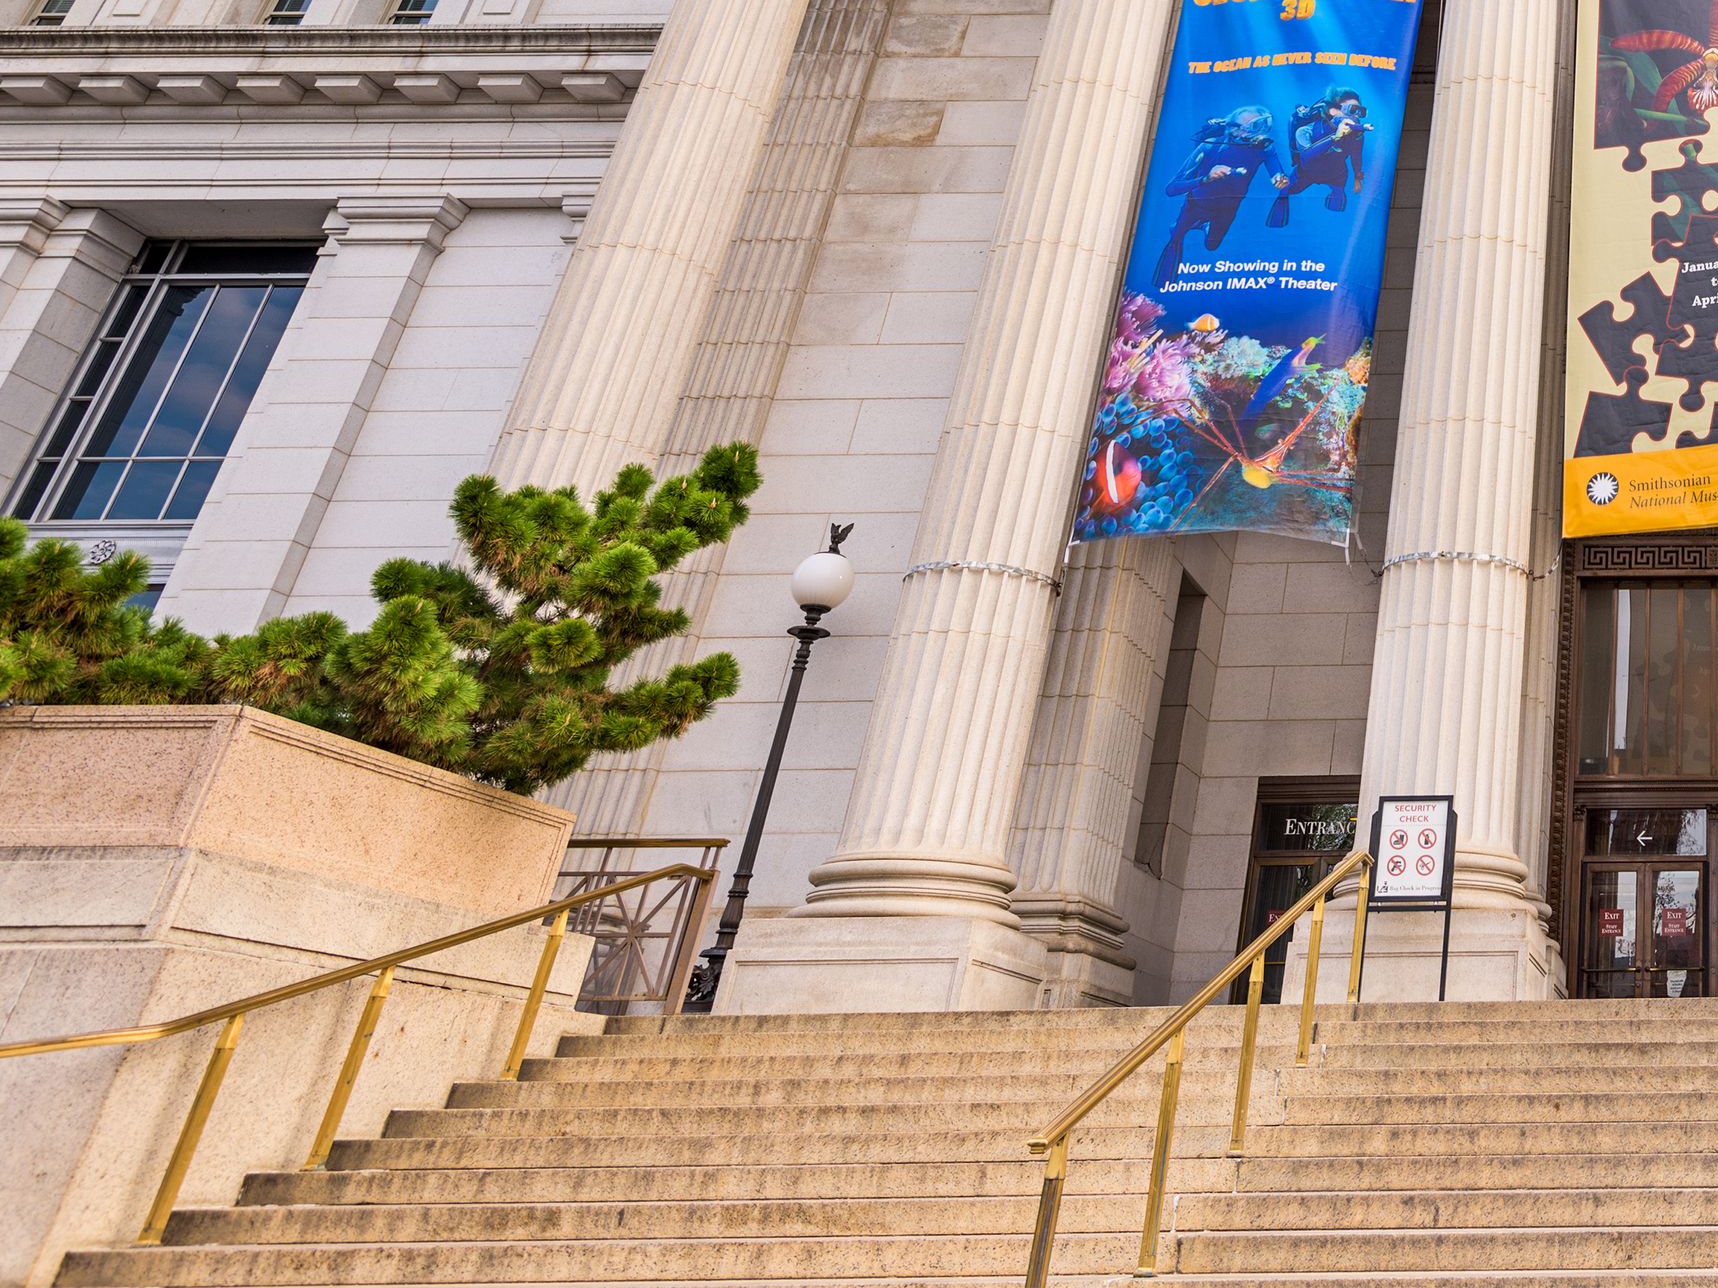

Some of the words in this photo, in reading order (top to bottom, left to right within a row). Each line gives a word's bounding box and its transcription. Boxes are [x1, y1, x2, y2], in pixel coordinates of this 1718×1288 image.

[1188, 62, 1211, 74] THE
[1213, 56, 1252, 73] OCEAN
[1253, 55, 1270, 68] AS
[1271, 52, 1312, 66] NEVER
[1315, 52, 1347, 65] SEEN
[1349, 53, 1397, 71] BEFORE
[1177, 263, 1211, 274] Now
[1214, 260, 1279, 273] Showing
[1282, 259, 1296, 271] in
[1300, 260, 1325, 272] the
[1160, 279, 1222, 293] Johnson
[1279, 277, 1338, 292] Theater
[1629, 473, 1711, 493] Smithsonian
[1629, 491, 1686, 509] National
[1394, 804, 1437, 813] SECURITY
[1399, 815, 1429, 823] CHECK
[1283, 818, 1356, 836] ENTRANC
[1604, 912, 1620, 920] EXIT
[1667, 911, 1682, 919] EXIT
